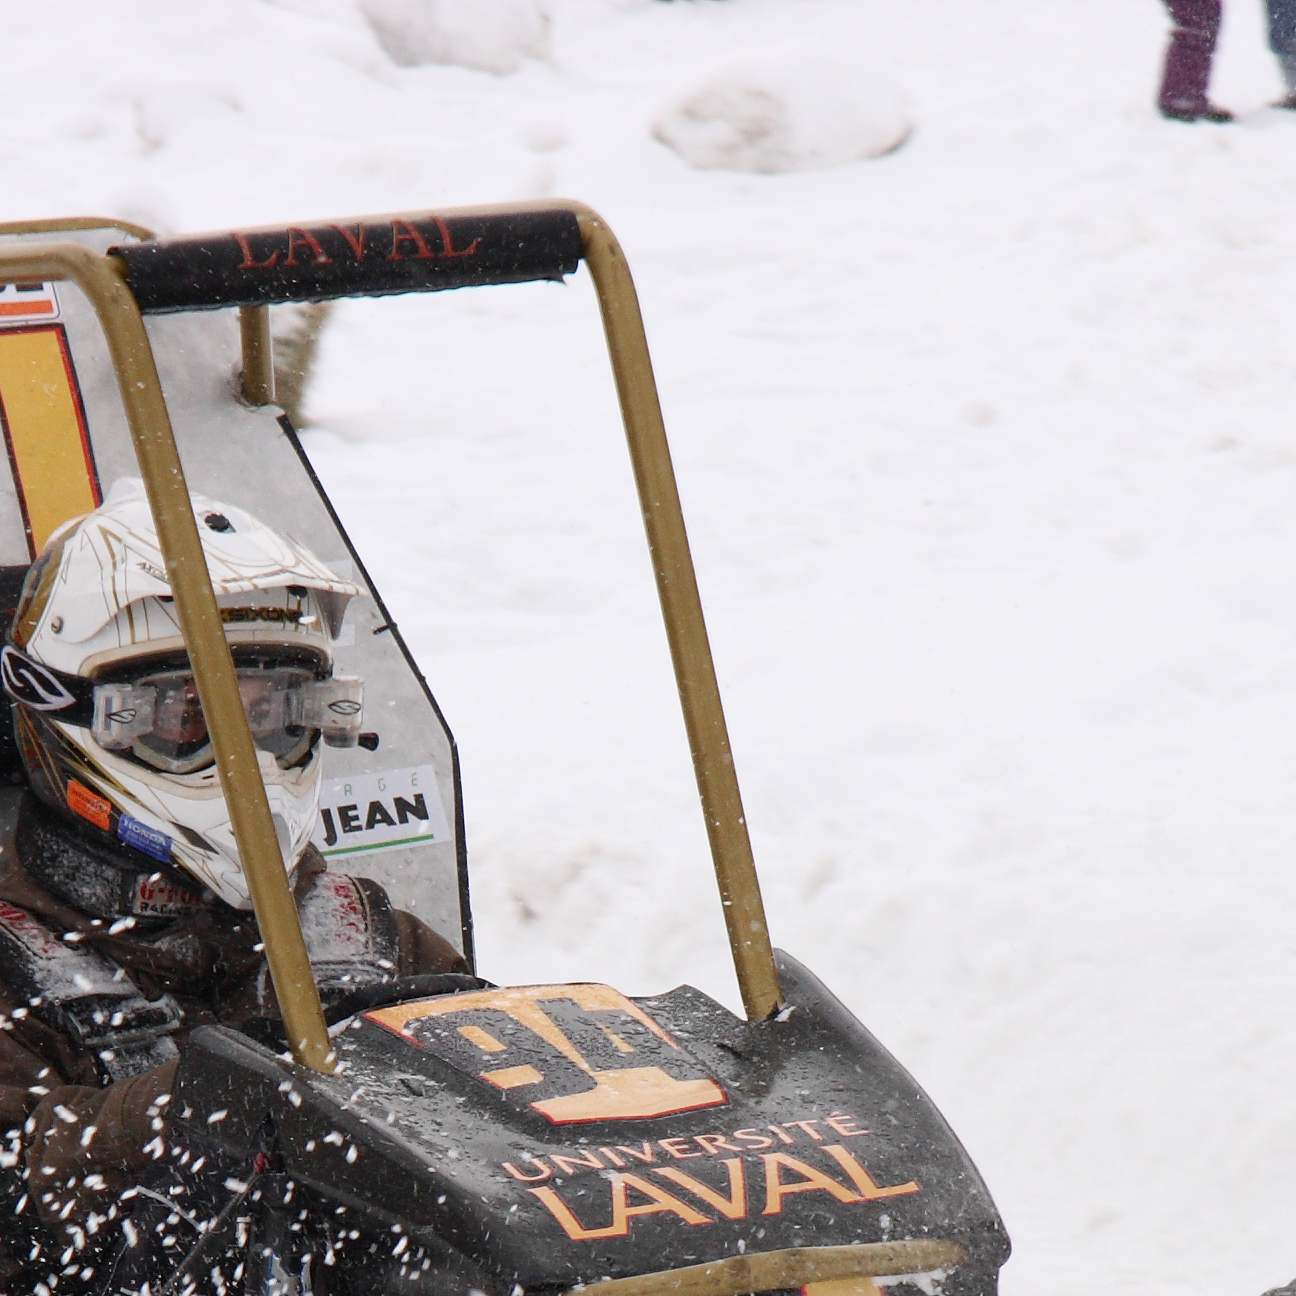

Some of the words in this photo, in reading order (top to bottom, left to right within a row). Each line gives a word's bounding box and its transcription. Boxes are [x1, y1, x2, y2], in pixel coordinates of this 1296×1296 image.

[230, 215, 483, 270] LAVAL
[321, 793, 429, 847] JEAN
[502, 1112, 872, 1183] UNIVERSITÉ
[526, 1143, 922, 1242] LAVAL
